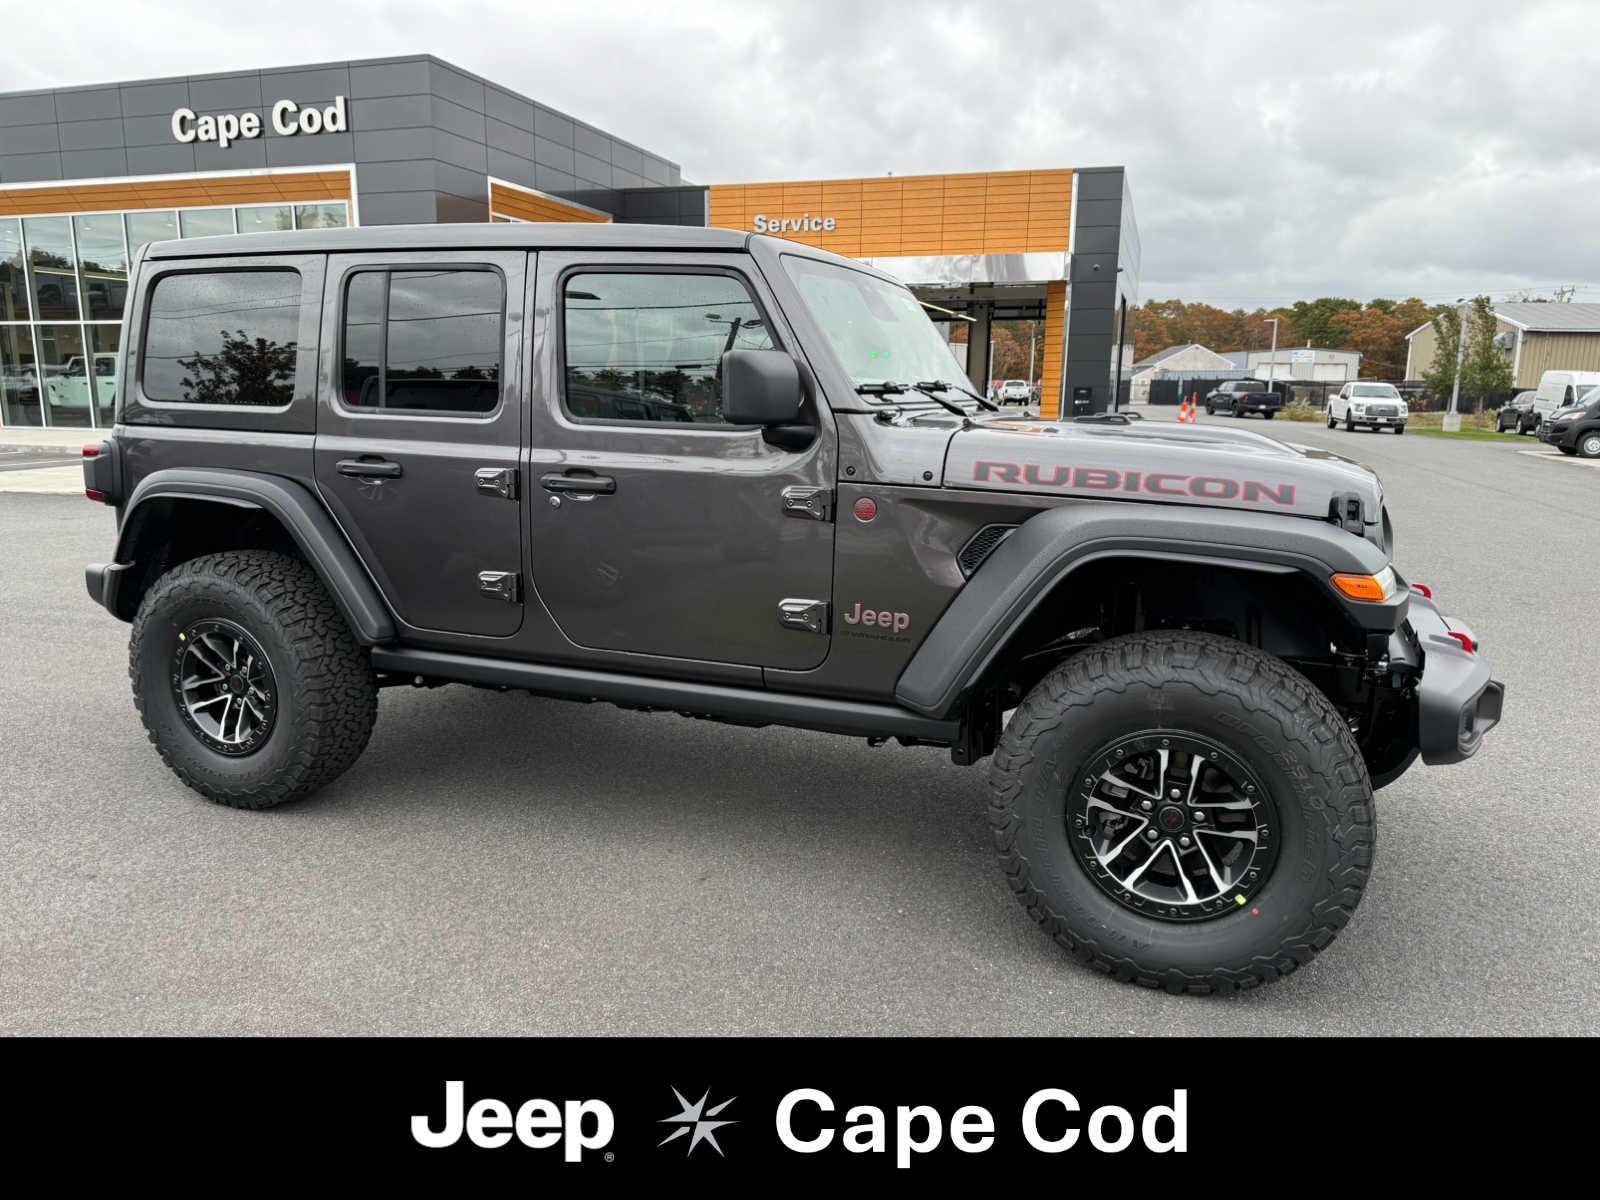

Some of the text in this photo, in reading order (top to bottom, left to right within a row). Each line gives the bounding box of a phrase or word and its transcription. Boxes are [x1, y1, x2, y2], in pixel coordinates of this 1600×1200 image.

[171, 96, 348, 148] Cape Cod
[753, 213, 836, 233] Service
[973, 461, 1296, 506] RUBICON
[844, 603, 910, 633] Jeep
